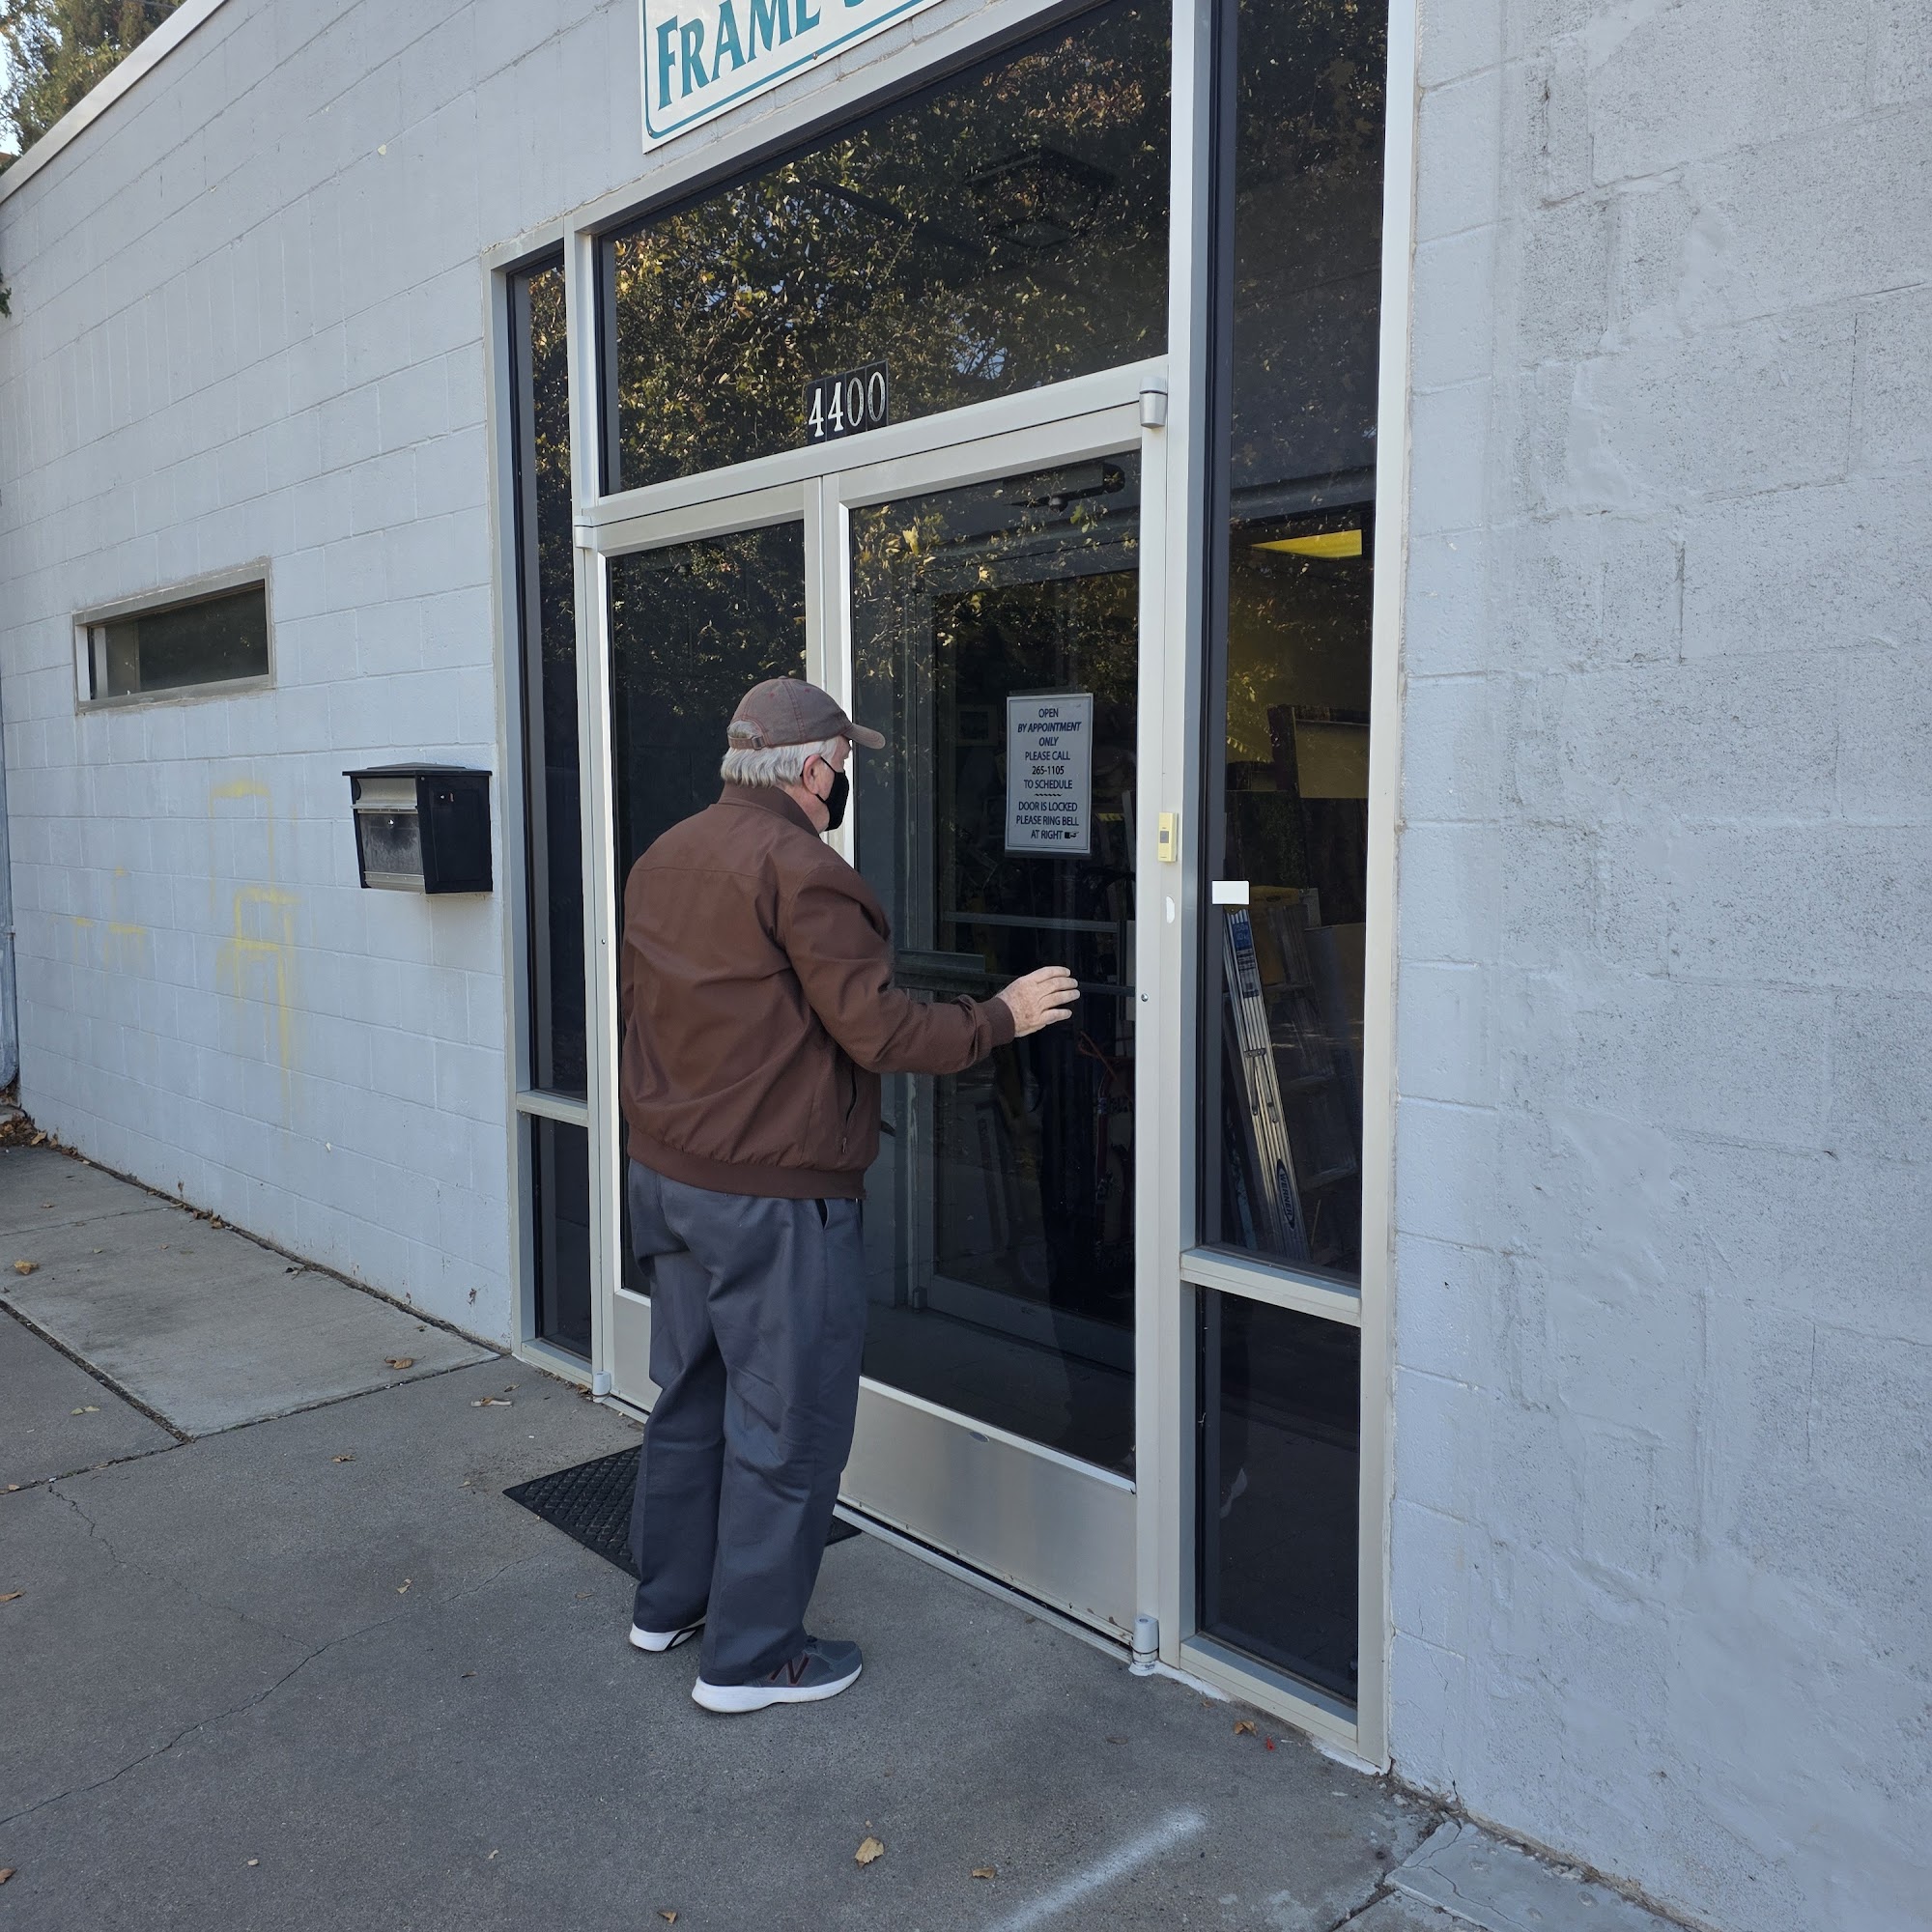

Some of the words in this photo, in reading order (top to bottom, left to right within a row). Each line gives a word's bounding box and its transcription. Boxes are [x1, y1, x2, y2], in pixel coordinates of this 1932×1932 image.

[809, 371, 886, 438] 4400
[1038, 708, 1059, 718] OPEN
[1017, 723, 1027, 733] BY
[1028, 722, 1082, 733] APPOINTMENT
[1038, 737, 1059, 747] ONLY
[1025, 752, 1051, 760] PLEASE
[1052, 751, 1070, 760] CALL
[1032, 766, 1065, 775] 265-1105
[1024, 780, 1035, 789] TO
[1035, 780, 1072, 789] SCHEDULE
[1018, 802, 1039, 810] DOOR
[1041, 802, 1047, 811] IS
[1048, 802, 1078, 811] LOCKED
[1016, 815, 1042, 825] PLEASE
[1043, 816, 1061, 825] RING
[1063, 816, 1079, 826] BELL
[1031, 830, 1039, 838] AT
[1041, 830, 1063, 839] RIGHT
[1279, 1172, 1293, 1217] WERNER
